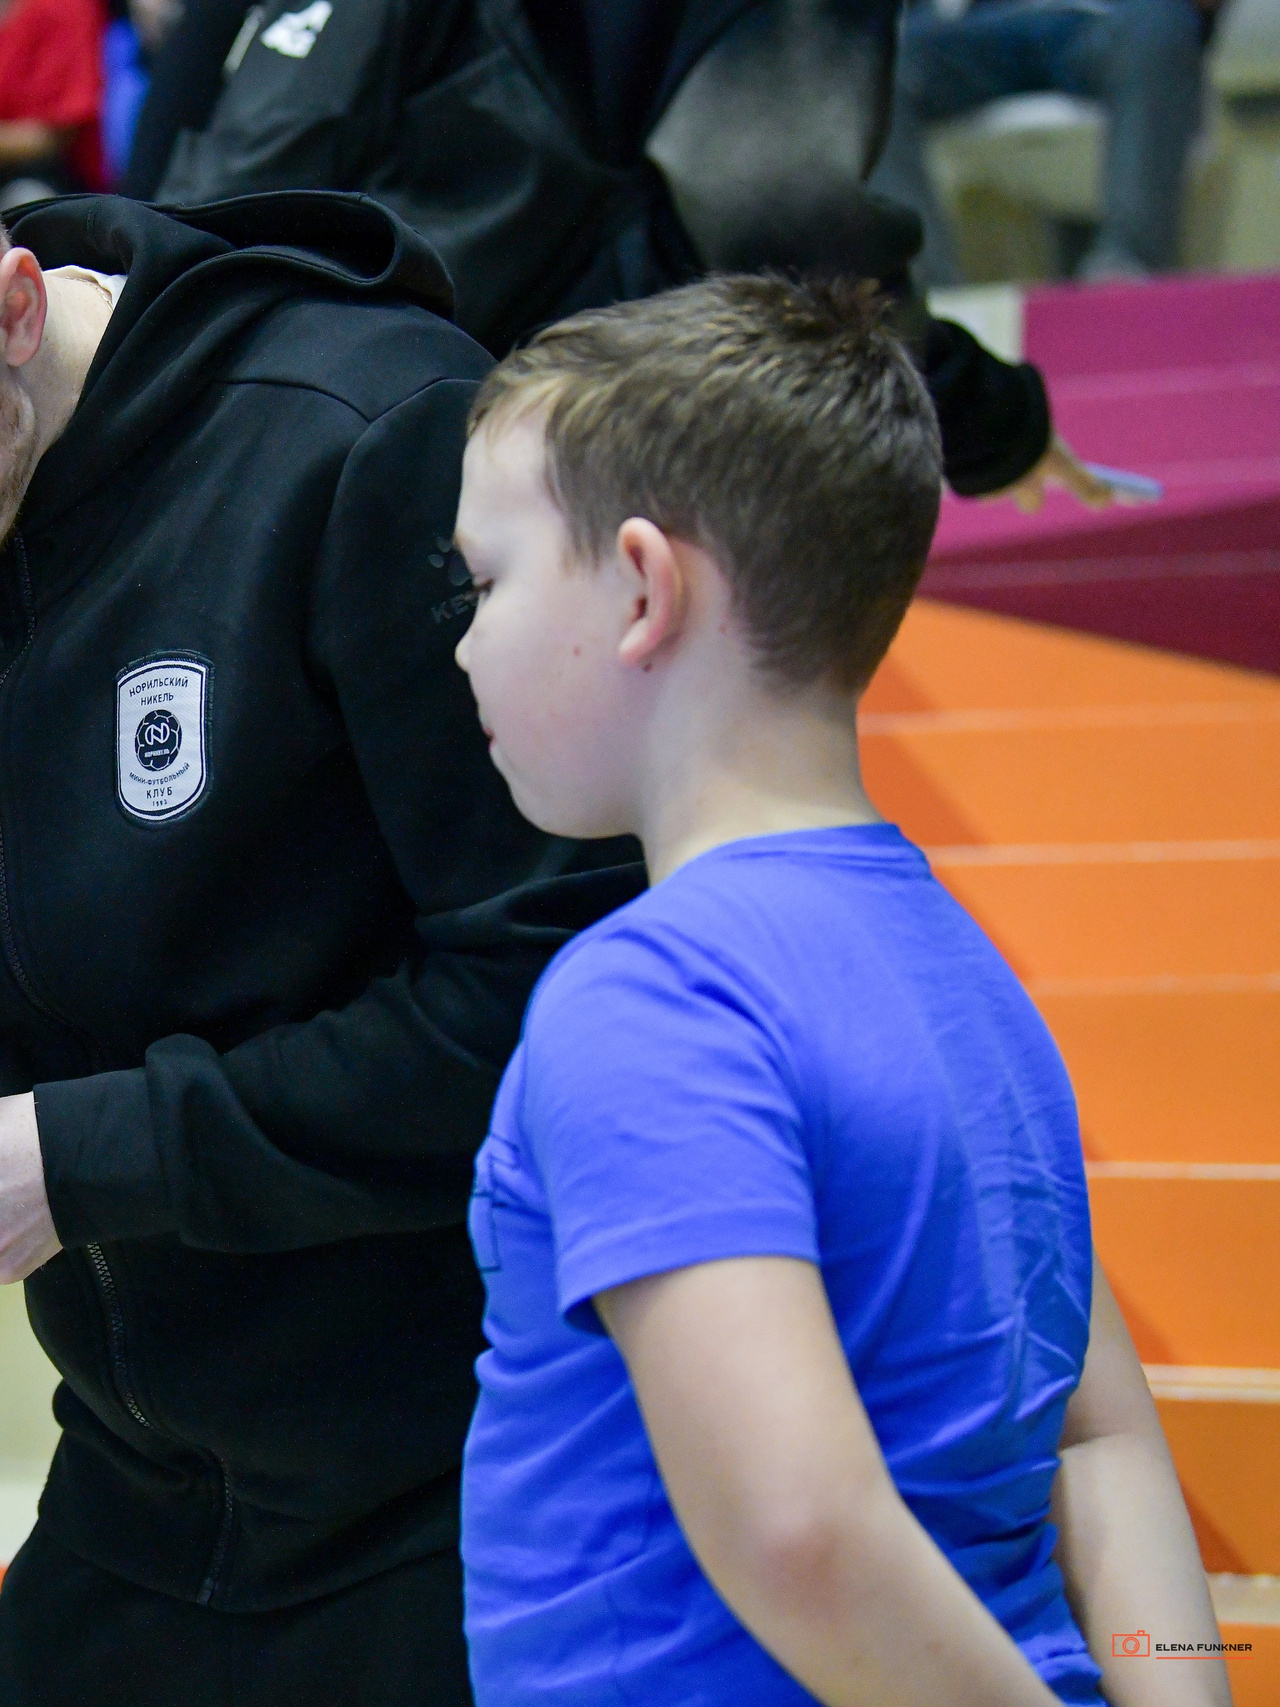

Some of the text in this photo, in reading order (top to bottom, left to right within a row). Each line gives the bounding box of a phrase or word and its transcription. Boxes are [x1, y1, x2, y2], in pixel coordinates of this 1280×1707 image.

[129, 676, 189, 698] НОРИЛЬСКИЙ
[140, 692, 174, 706] НИКЕЛЬ
[129, 762, 190, 786] МИНИ-ФУТБОЛЬНЫЙ
[146, 786, 173, 800] КЛУБ
